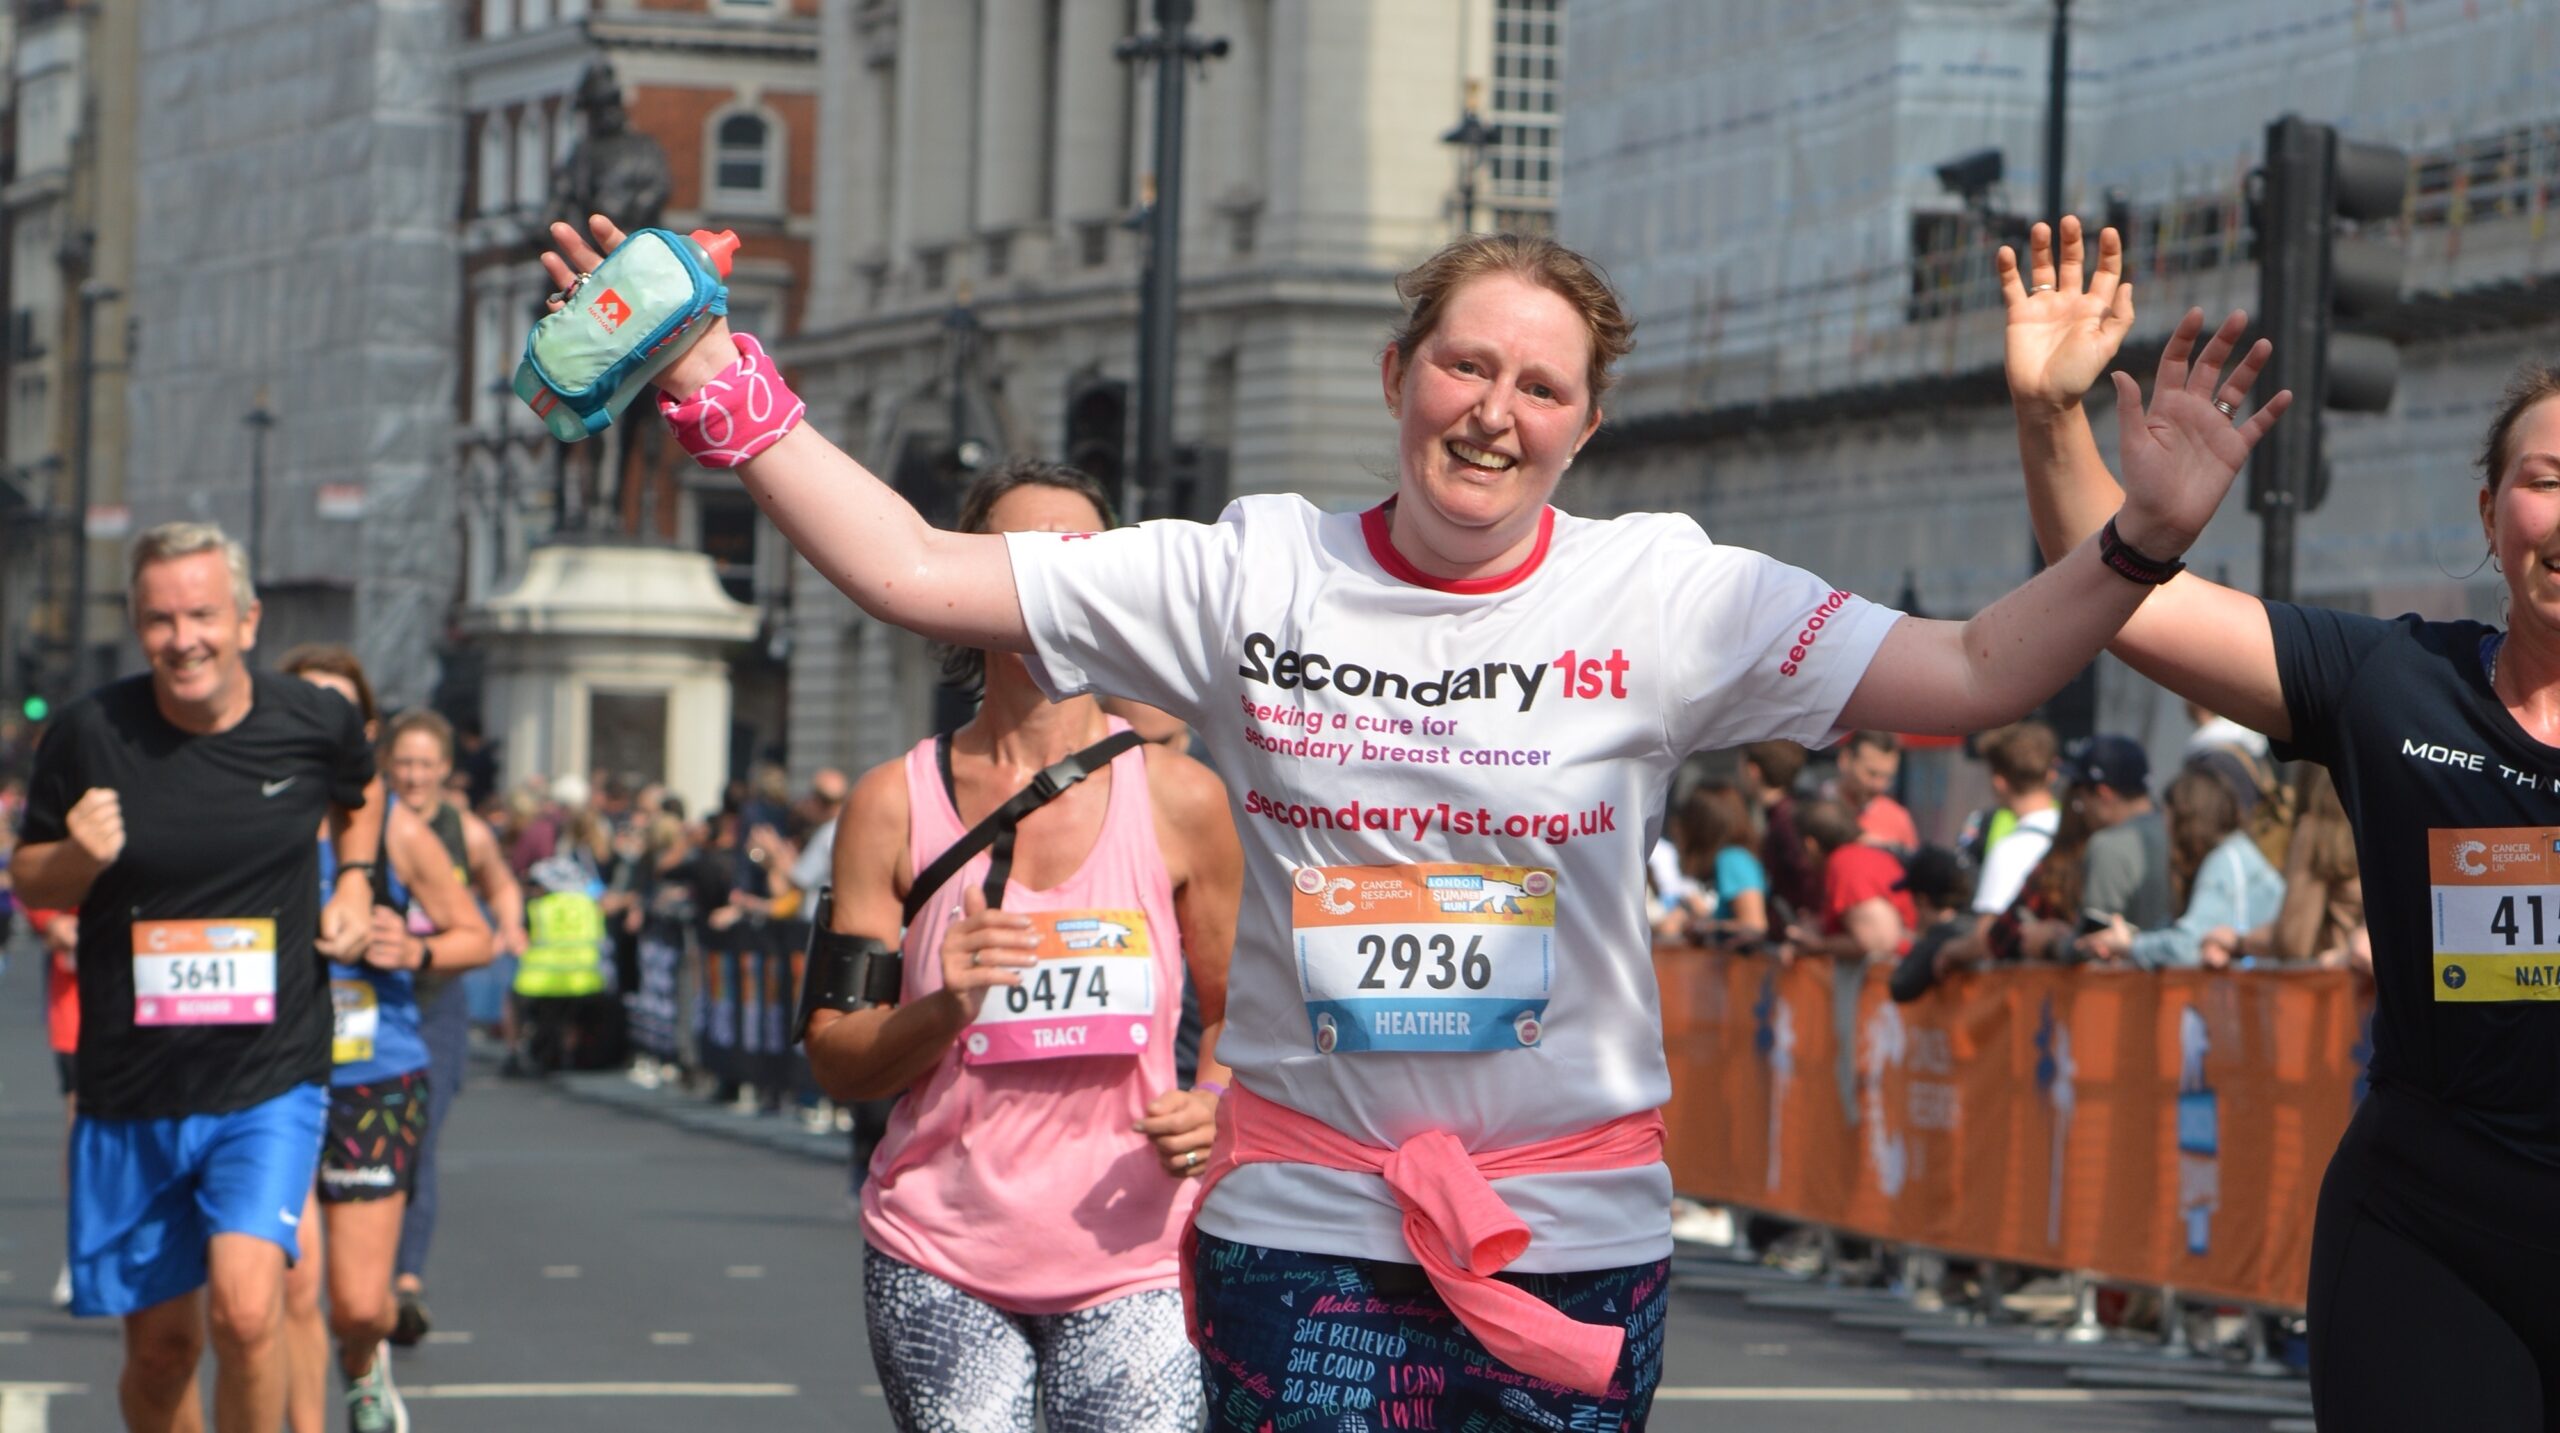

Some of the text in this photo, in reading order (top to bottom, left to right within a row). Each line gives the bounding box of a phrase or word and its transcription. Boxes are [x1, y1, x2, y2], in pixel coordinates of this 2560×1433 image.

[586, 306, 615, 336] NATHAN
[1239, 632, 1630, 713] Secondary1st
[1332, 713, 1348, 730] a
[1355, 714, 1414, 736] cure
[1422, 715, 1459, 737] for
[1245, 725, 1551, 766] secondary breast cancer
[2401, 738, 2486, 772] MORE
[1244, 789, 1617, 845] secondary1st.org.uk
[2492, 844, 2530, 853] CANCER
[2492, 854, 2541, 862] RESEARCH
[2492, 864, 2506, 872] UK
[1361, 880, 1403, 890] CANCER
[1361, 889, 1413, 900] RESEARCH
[1427, 878, 1480, 888] LONDON
[1361, 901, 1375, 910] UK
[1443, 902, 1467, 912] RUN
[2491, 895, 2560, 946] 41
[169, 959, 236, 990] 5641
[1357, 933, 1491, 990] 2936
[1006, 966, 1109, 1014] 6474
[1032, 1026, 1088, 1048] TRACY
[1375, 1011, 1471, 1036] HEATHER
[1309, 1294, 1361, 1317] Make
[1364, 1297, 1391, 1313] the
[1294, 1317, 1407, 1359] SHE BELIEVED
[1399, 1319, 1437, 1350] born
[1443, 1337, 1459, 1357] to
[1287, 1347, 1376, 1383] SHE COULD
[1464, 1364, 1482, 1377] on
[1484, 1363, 1525, 1387] brave
[1282, 1377, 1303, 1405] SO
[1305, 1380, 1341, 1406] SHE
[1389, 1364, 1446, 1396] I CAN
[1275, 1405, 1318, 1433] born
[1379, 1399, 1389, 1429] I
[1392, 1397, 1439, 1431] WILL
